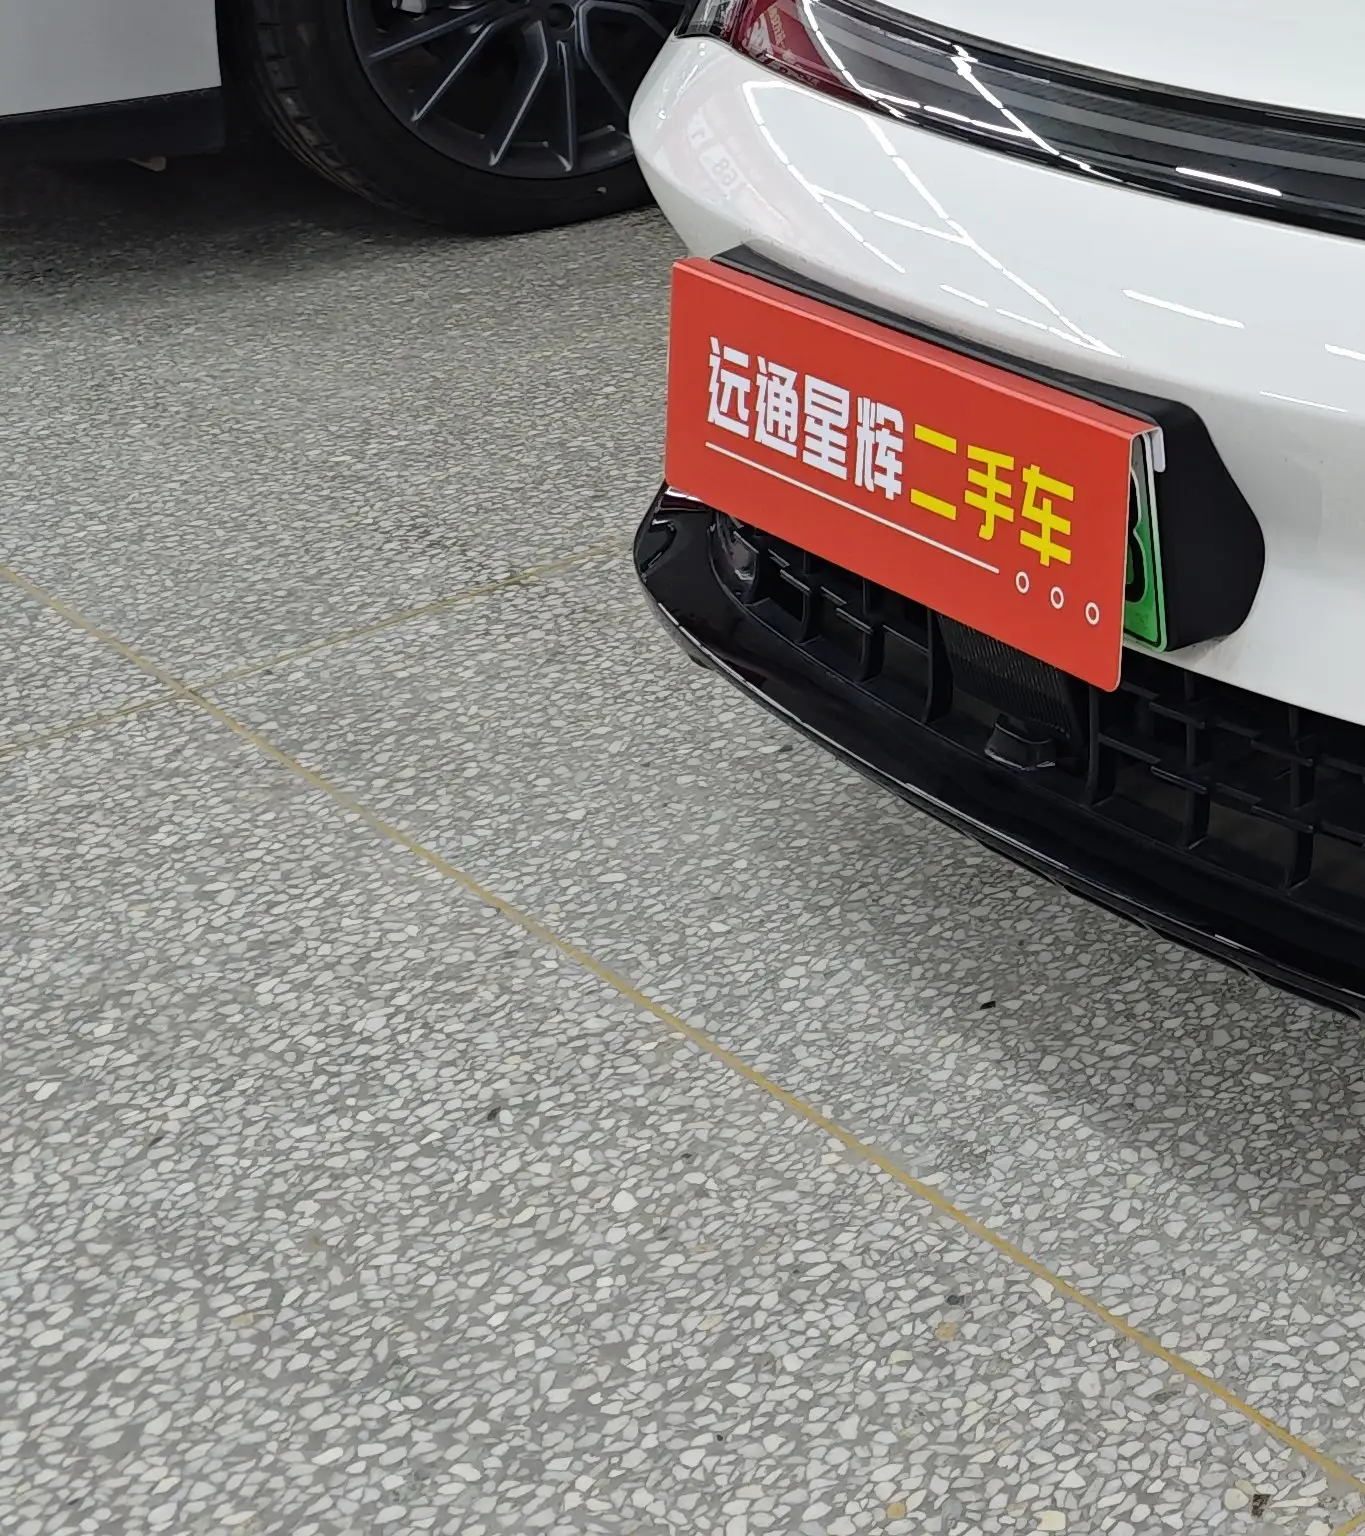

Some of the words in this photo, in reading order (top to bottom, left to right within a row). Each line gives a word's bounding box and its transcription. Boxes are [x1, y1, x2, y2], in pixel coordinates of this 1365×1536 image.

[706, 336, 1075, 567] 远通星辉二手车
